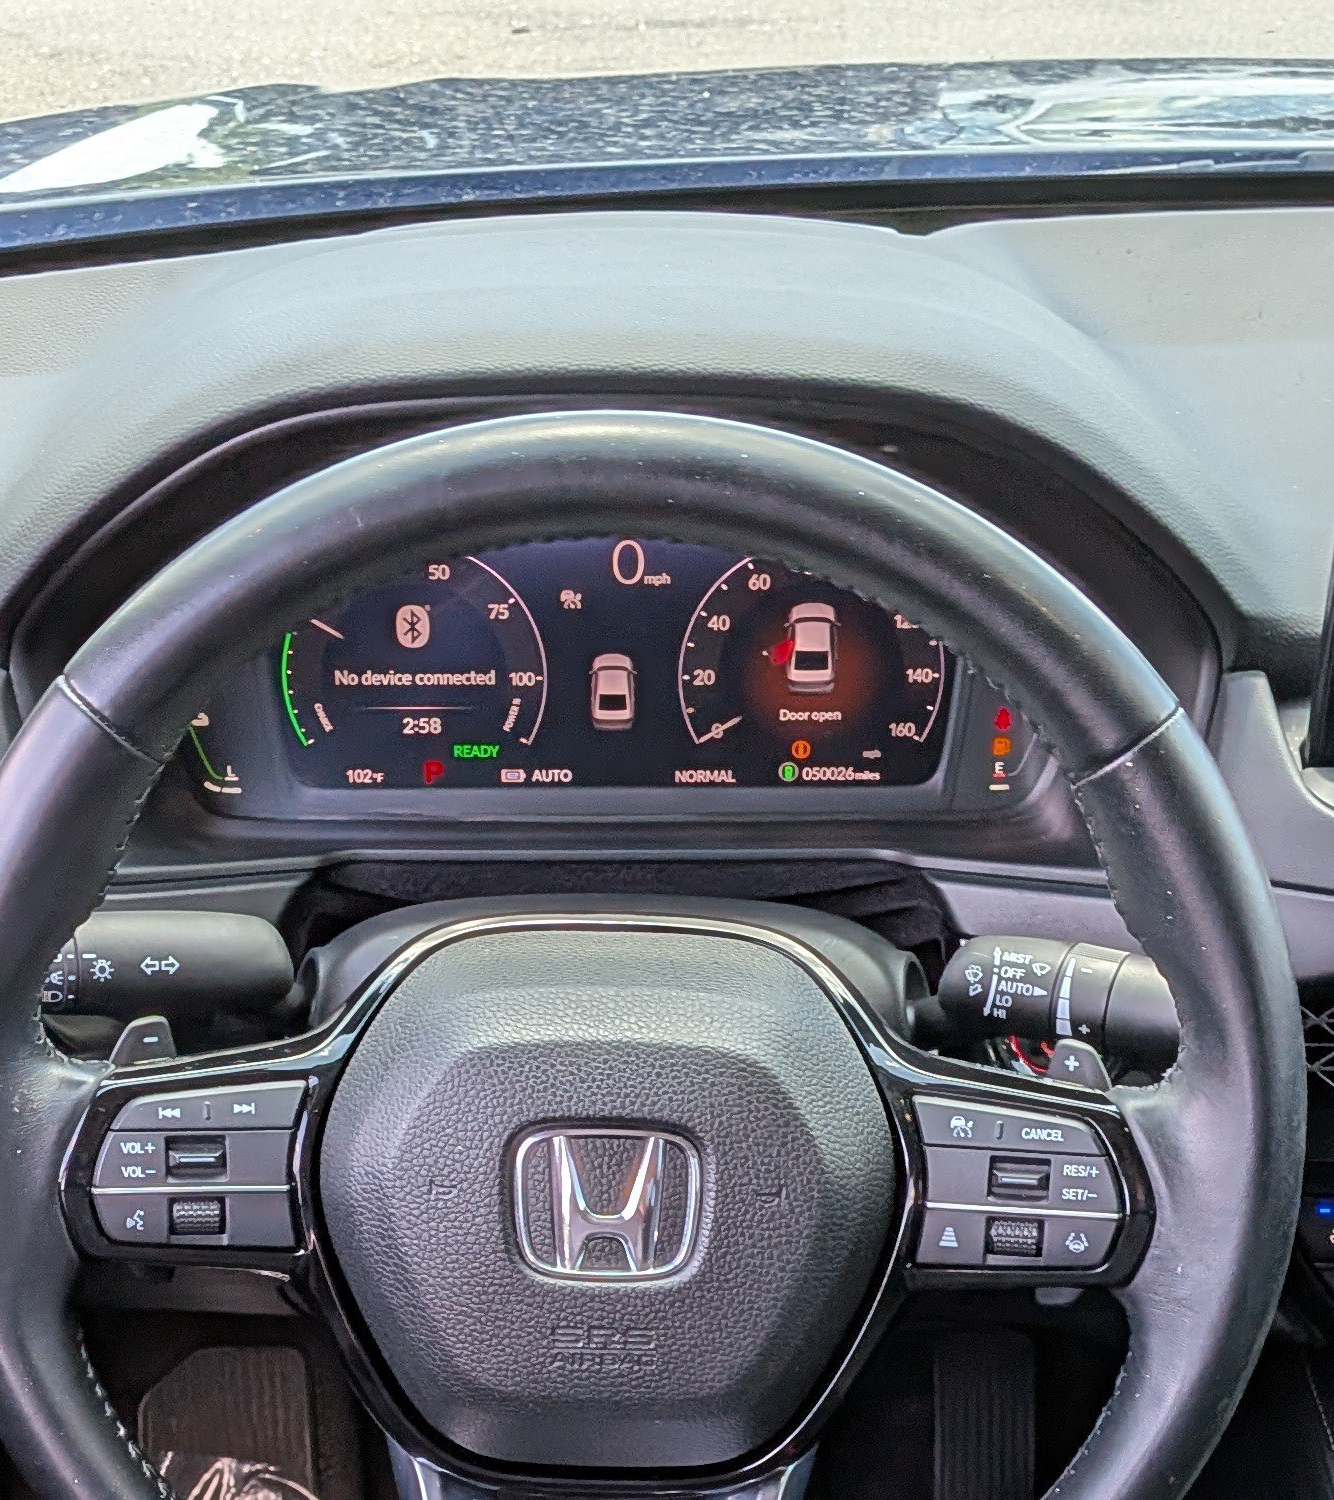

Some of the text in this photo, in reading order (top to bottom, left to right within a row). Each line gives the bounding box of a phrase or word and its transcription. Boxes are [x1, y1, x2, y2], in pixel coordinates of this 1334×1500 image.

[612, 539, 672, 587] 0 mph
[427, 564, 451, 580] 50
[747, 573, 771, 590] 60
[487, 603, 510, 620] 75
[707, 614, 730, 631] 40
[334, 669, 496, 686] No device connected
[508, 671, 535, 687] 100
[693, 669, 716, 686] 20
[906, 667, 933, 683] 140
[778, 708, 842, 723] Door open
[402, 717, 442, 735] 2:58
[889, 722, 916, 738] 160
[453, 745, 499, 758] READY
[423, 760, 444, 785] P
[531, 768, 573, 783] AUTO
[674, 770, 736, 783] NORMAL
[801, 766, 881, 781] 050026 miles
[994, 762, 1005, 775] E
[1000, 965, 1026, 980] OFF
[997, 980, 1033, 997] AUTO
[995, 993, 1013, 1008] LO
[993, 1007, 1007, 1020] HI
[1021, 1127, 1064, 1142] CANCEL
[1063, 1163, 1100, 1179] RES/+
